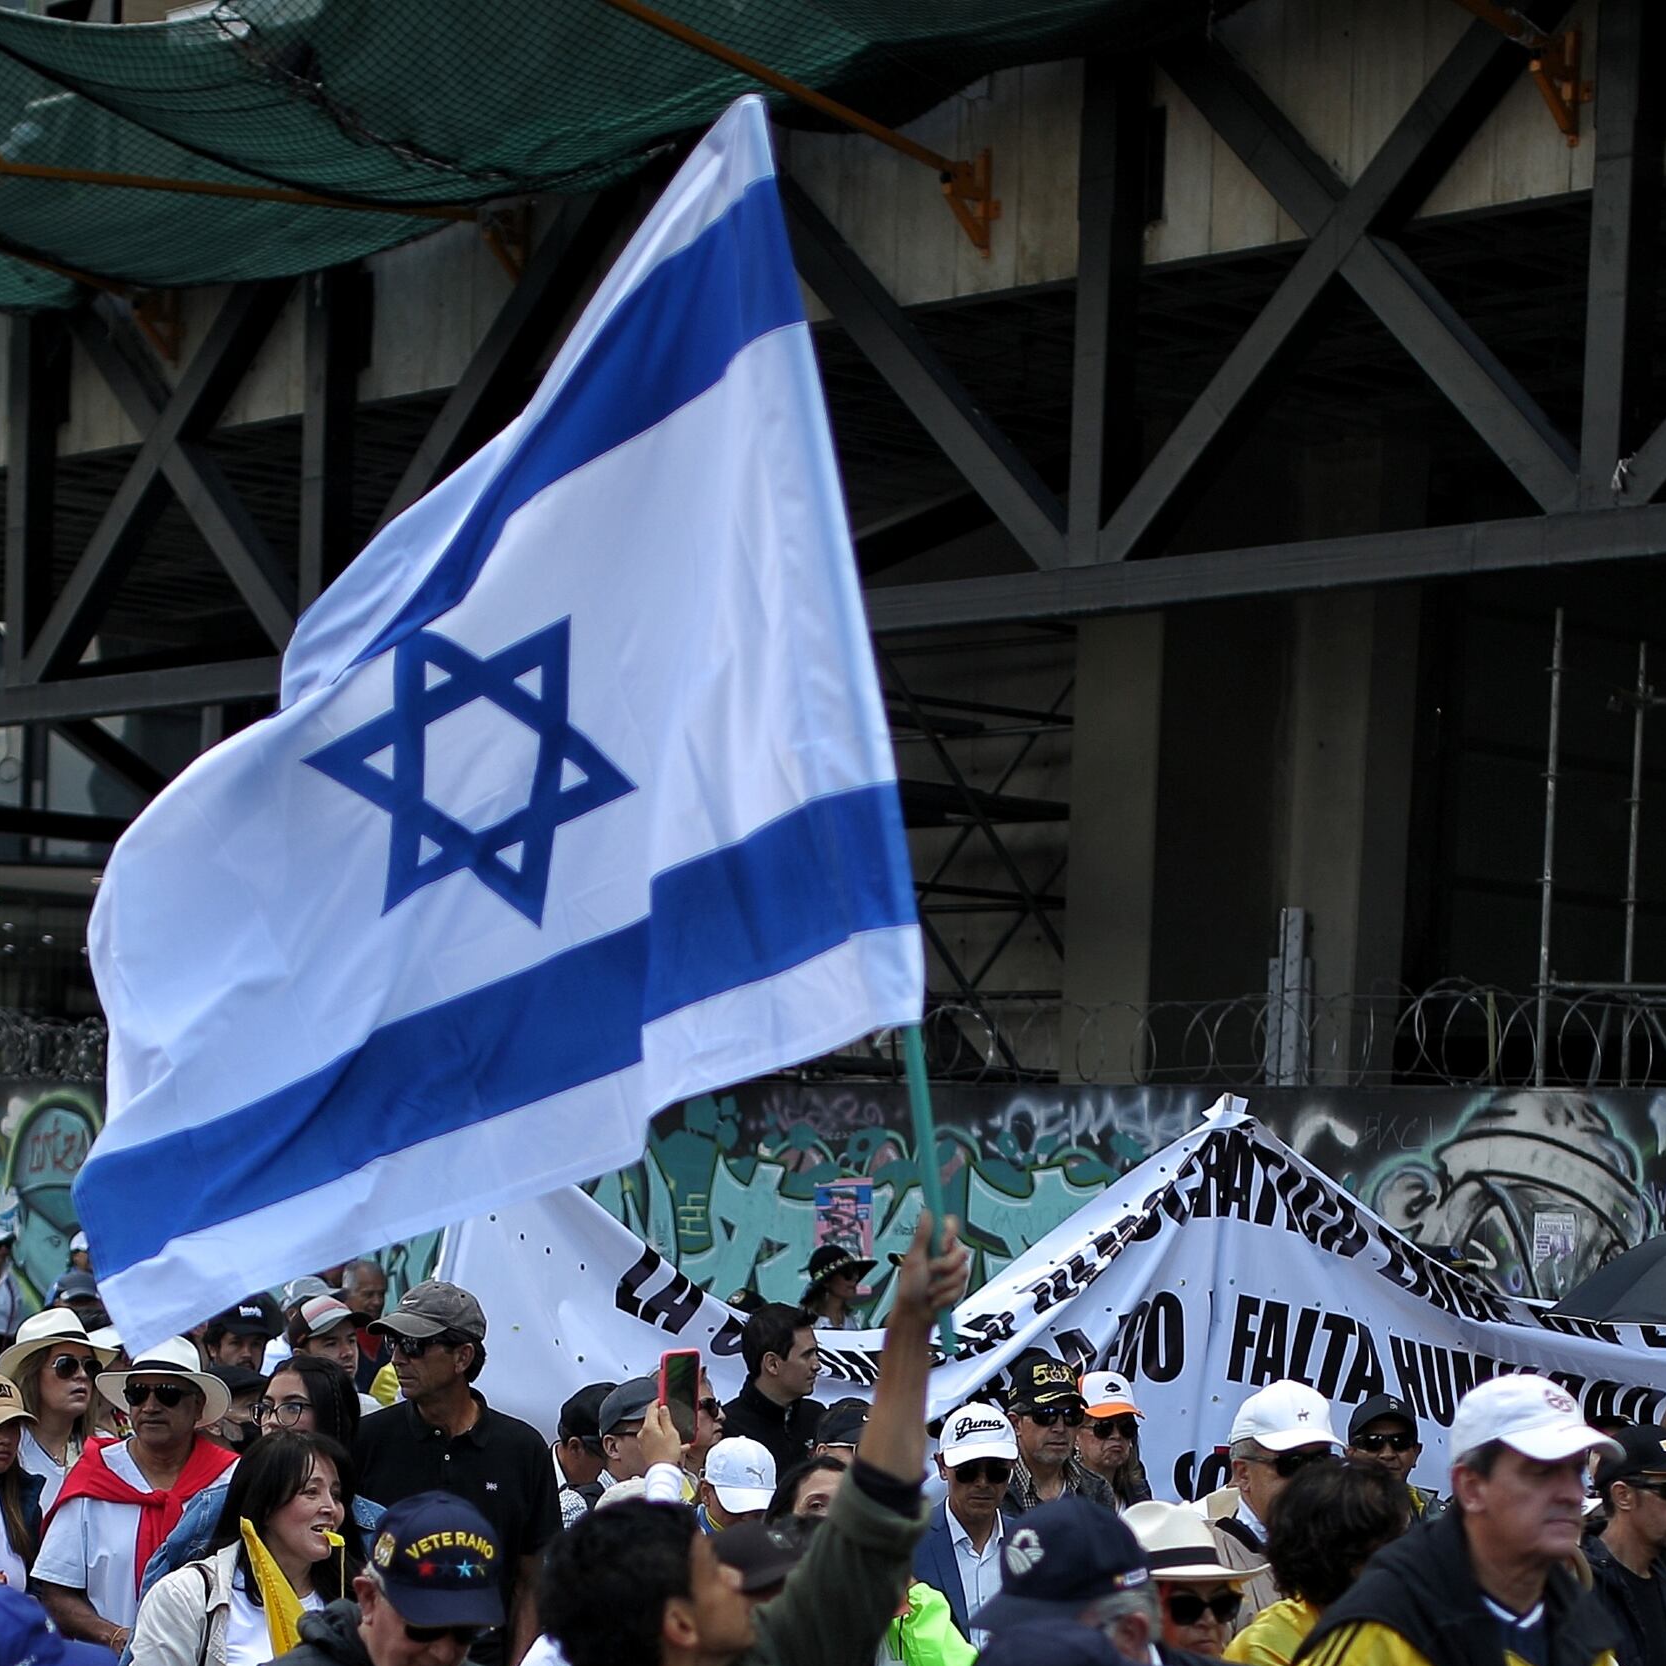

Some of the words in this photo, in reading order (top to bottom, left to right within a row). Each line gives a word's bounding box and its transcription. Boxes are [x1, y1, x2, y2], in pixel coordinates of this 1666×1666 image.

[616, 1246, 703, 1336] LA
[1227, 1294, 1386, 1406] FALTA
[955, 1417, 1005, 1442] Puma
[404, 1531, 494, 1561] VETERANO
